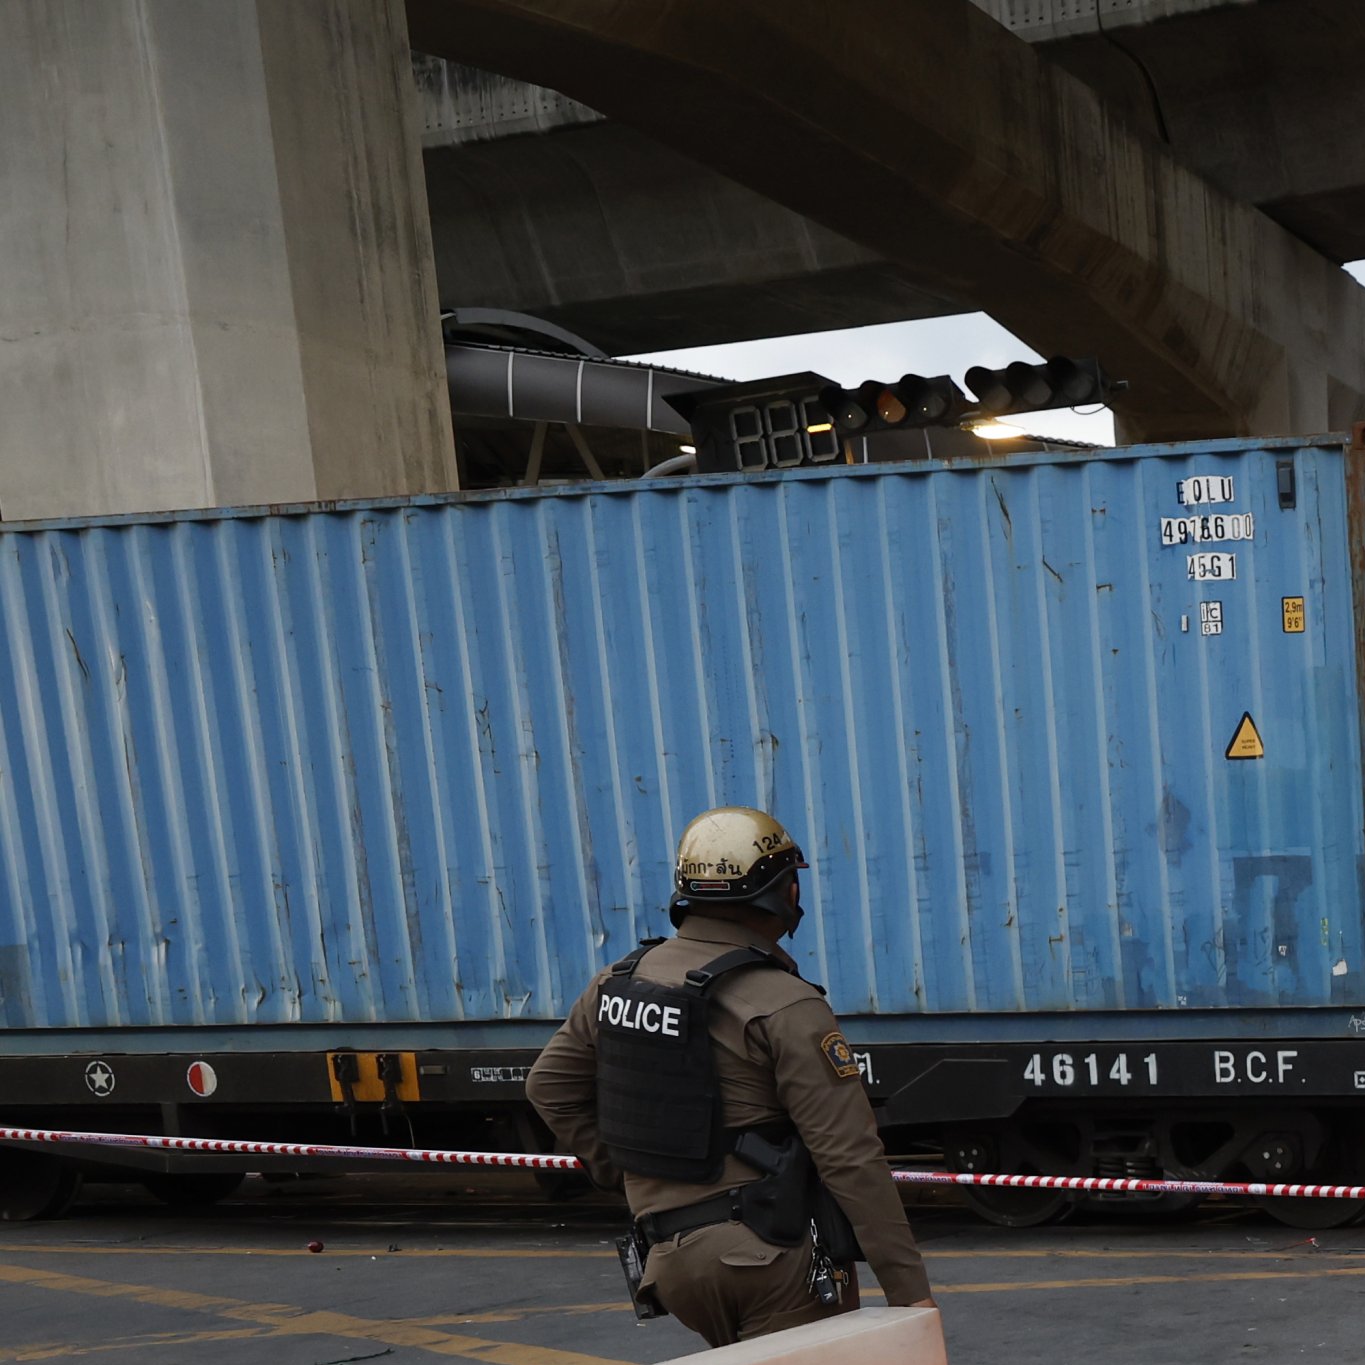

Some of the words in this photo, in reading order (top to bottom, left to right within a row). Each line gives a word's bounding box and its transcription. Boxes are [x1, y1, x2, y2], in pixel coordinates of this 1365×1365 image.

[1188, 553, 1235, 579] 45G1
[752, 833, 782, 854] 124
[598, 993, 682, 1037] POLICE
[1023, 1052, 1160, 1087] 46141
[1214, 1050, 1307, 1086] B.C.F.
